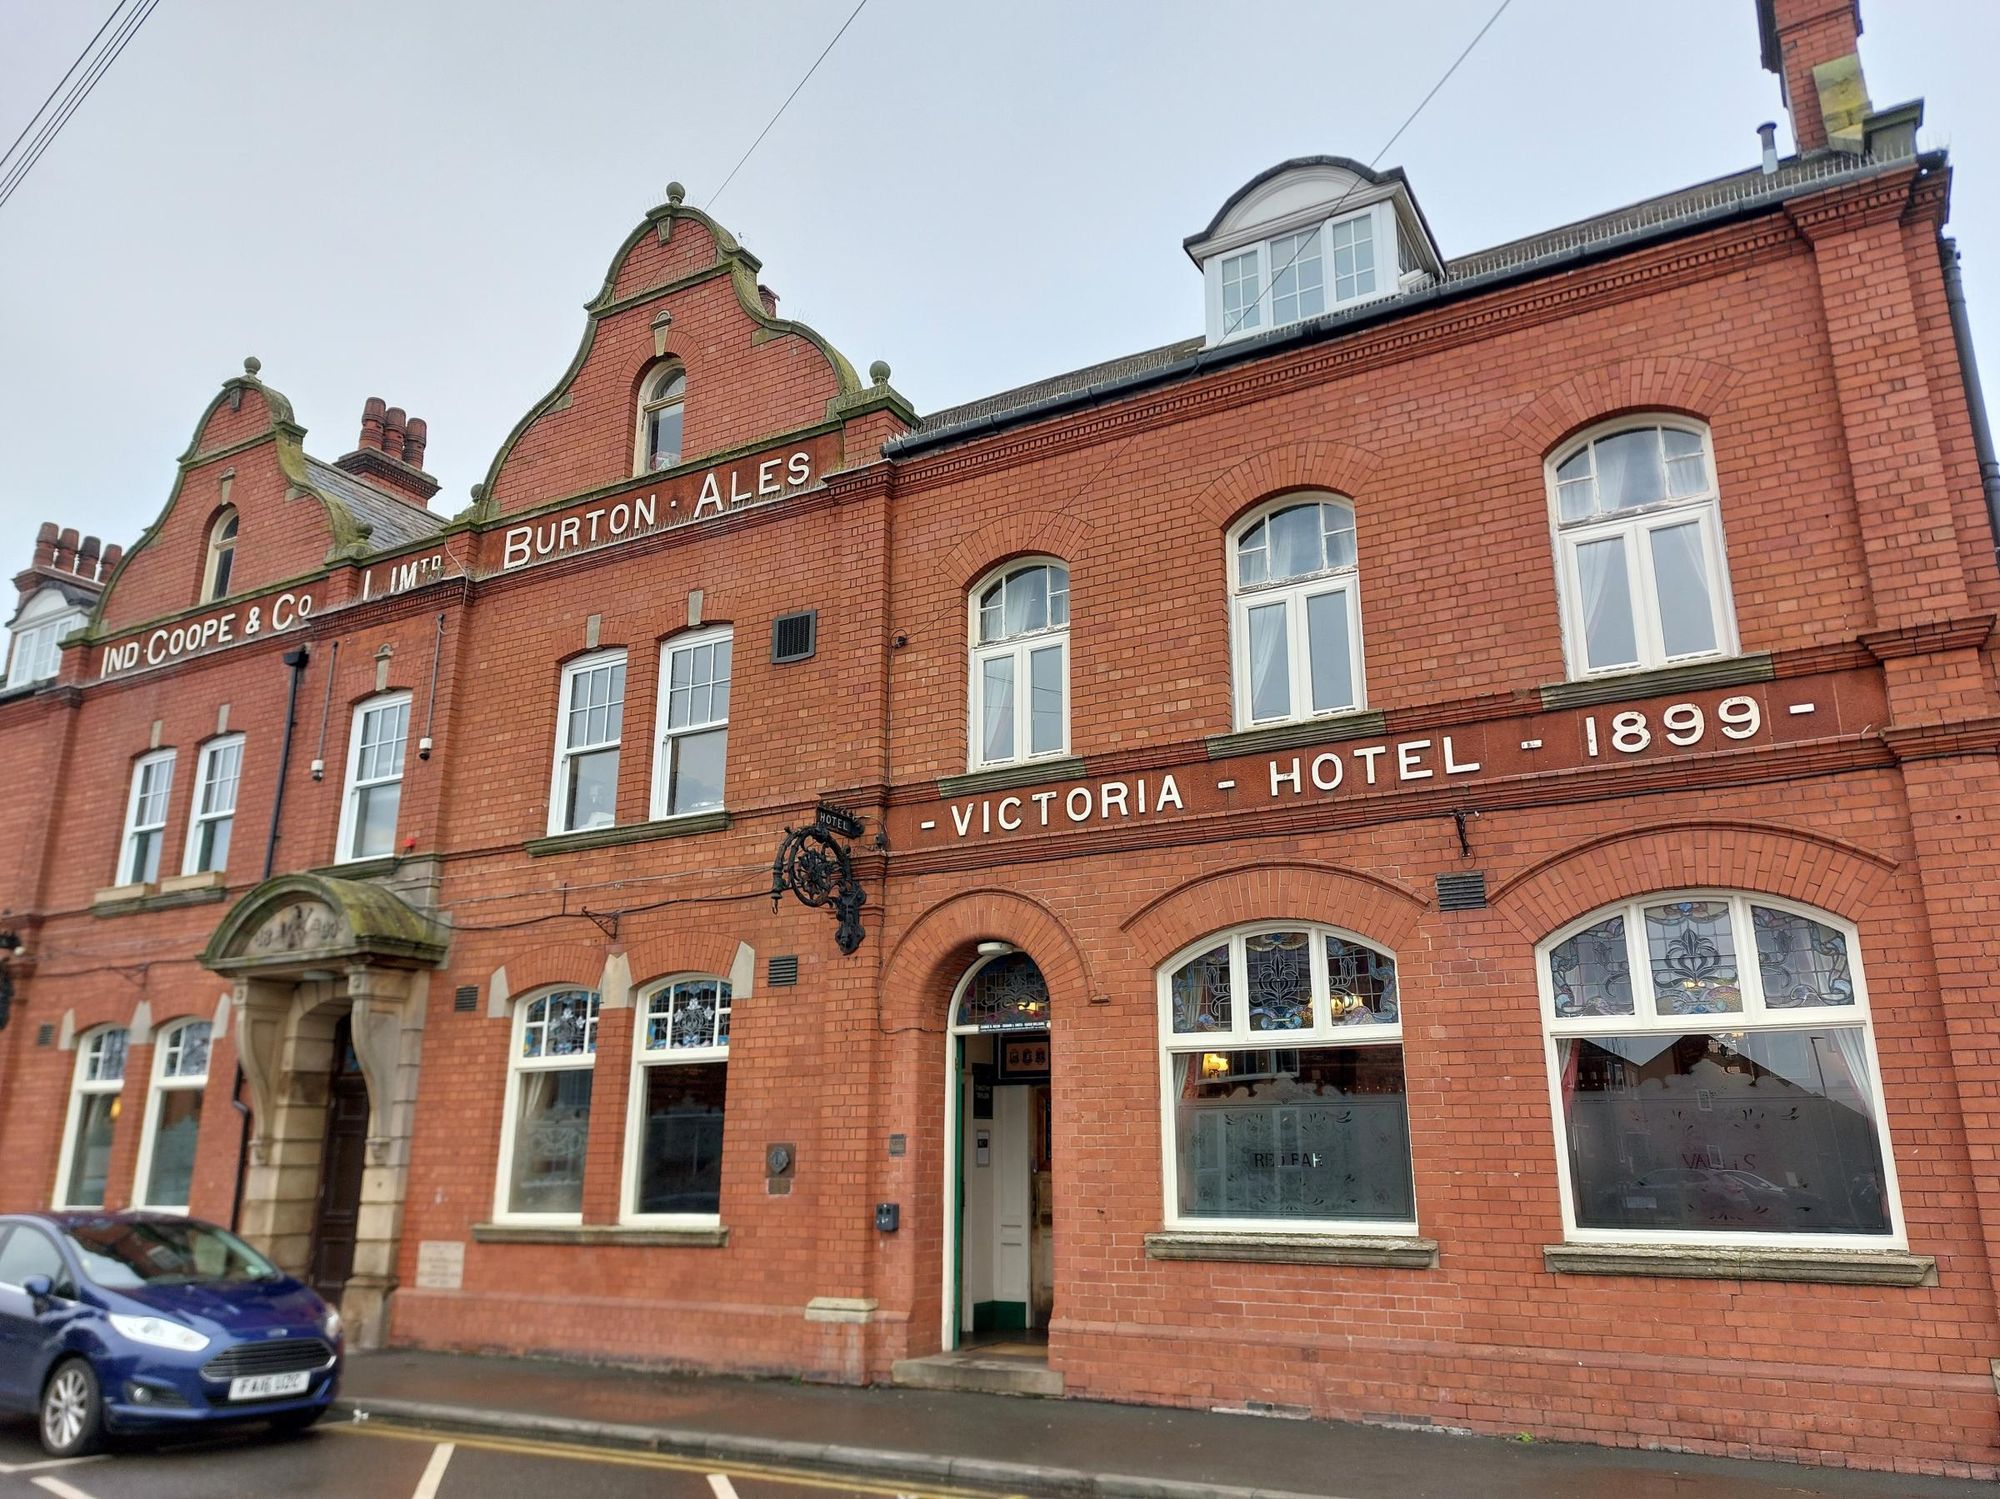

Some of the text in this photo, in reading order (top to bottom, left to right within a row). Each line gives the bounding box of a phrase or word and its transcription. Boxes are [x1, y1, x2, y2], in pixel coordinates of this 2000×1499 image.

[503, 494, 656, 570] BURTON
[693, 452, 811, 518] ALES
[101, 641, 139, 679] IND
[146, 613, 237, 665] COOPE
[245, 606, 261, 634] &
[950, 774, 1185, 837] VICTORIA
[1269, 736, 1481, 797] HOTEL
[1585, 695, 1762, 757] 1899
[820, 811, 848, 831] HOTEL
